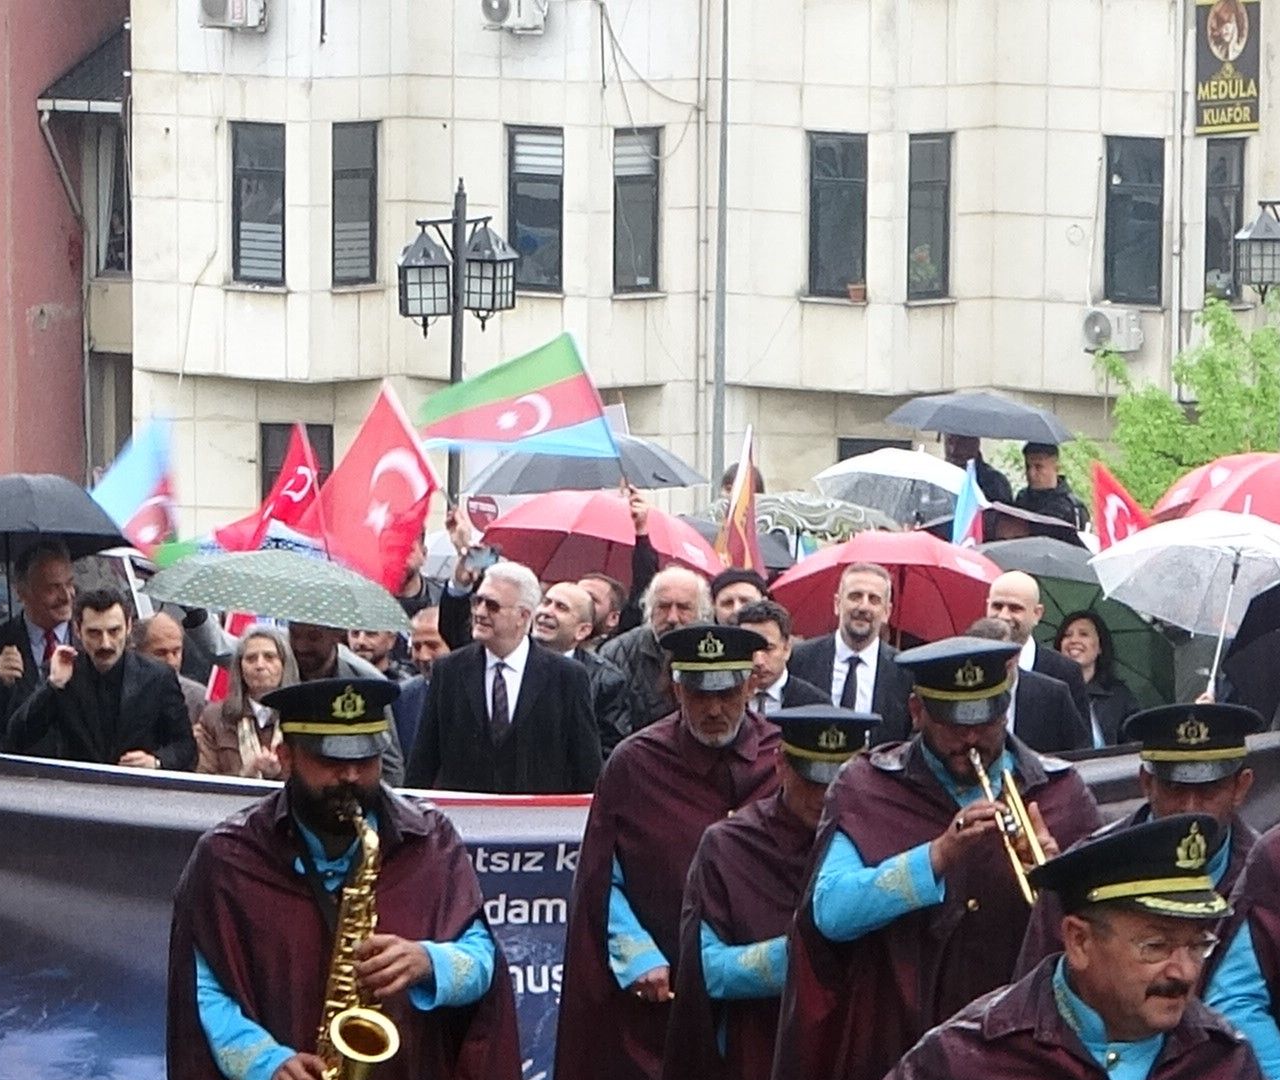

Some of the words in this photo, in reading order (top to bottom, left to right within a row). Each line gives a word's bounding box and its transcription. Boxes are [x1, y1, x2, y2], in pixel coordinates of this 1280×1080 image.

[1197, 79, 1258, 100] MEDULA
[1203, 102, 1251, 124] KUAFÖR
[466, 846, 545, 873] tsız
